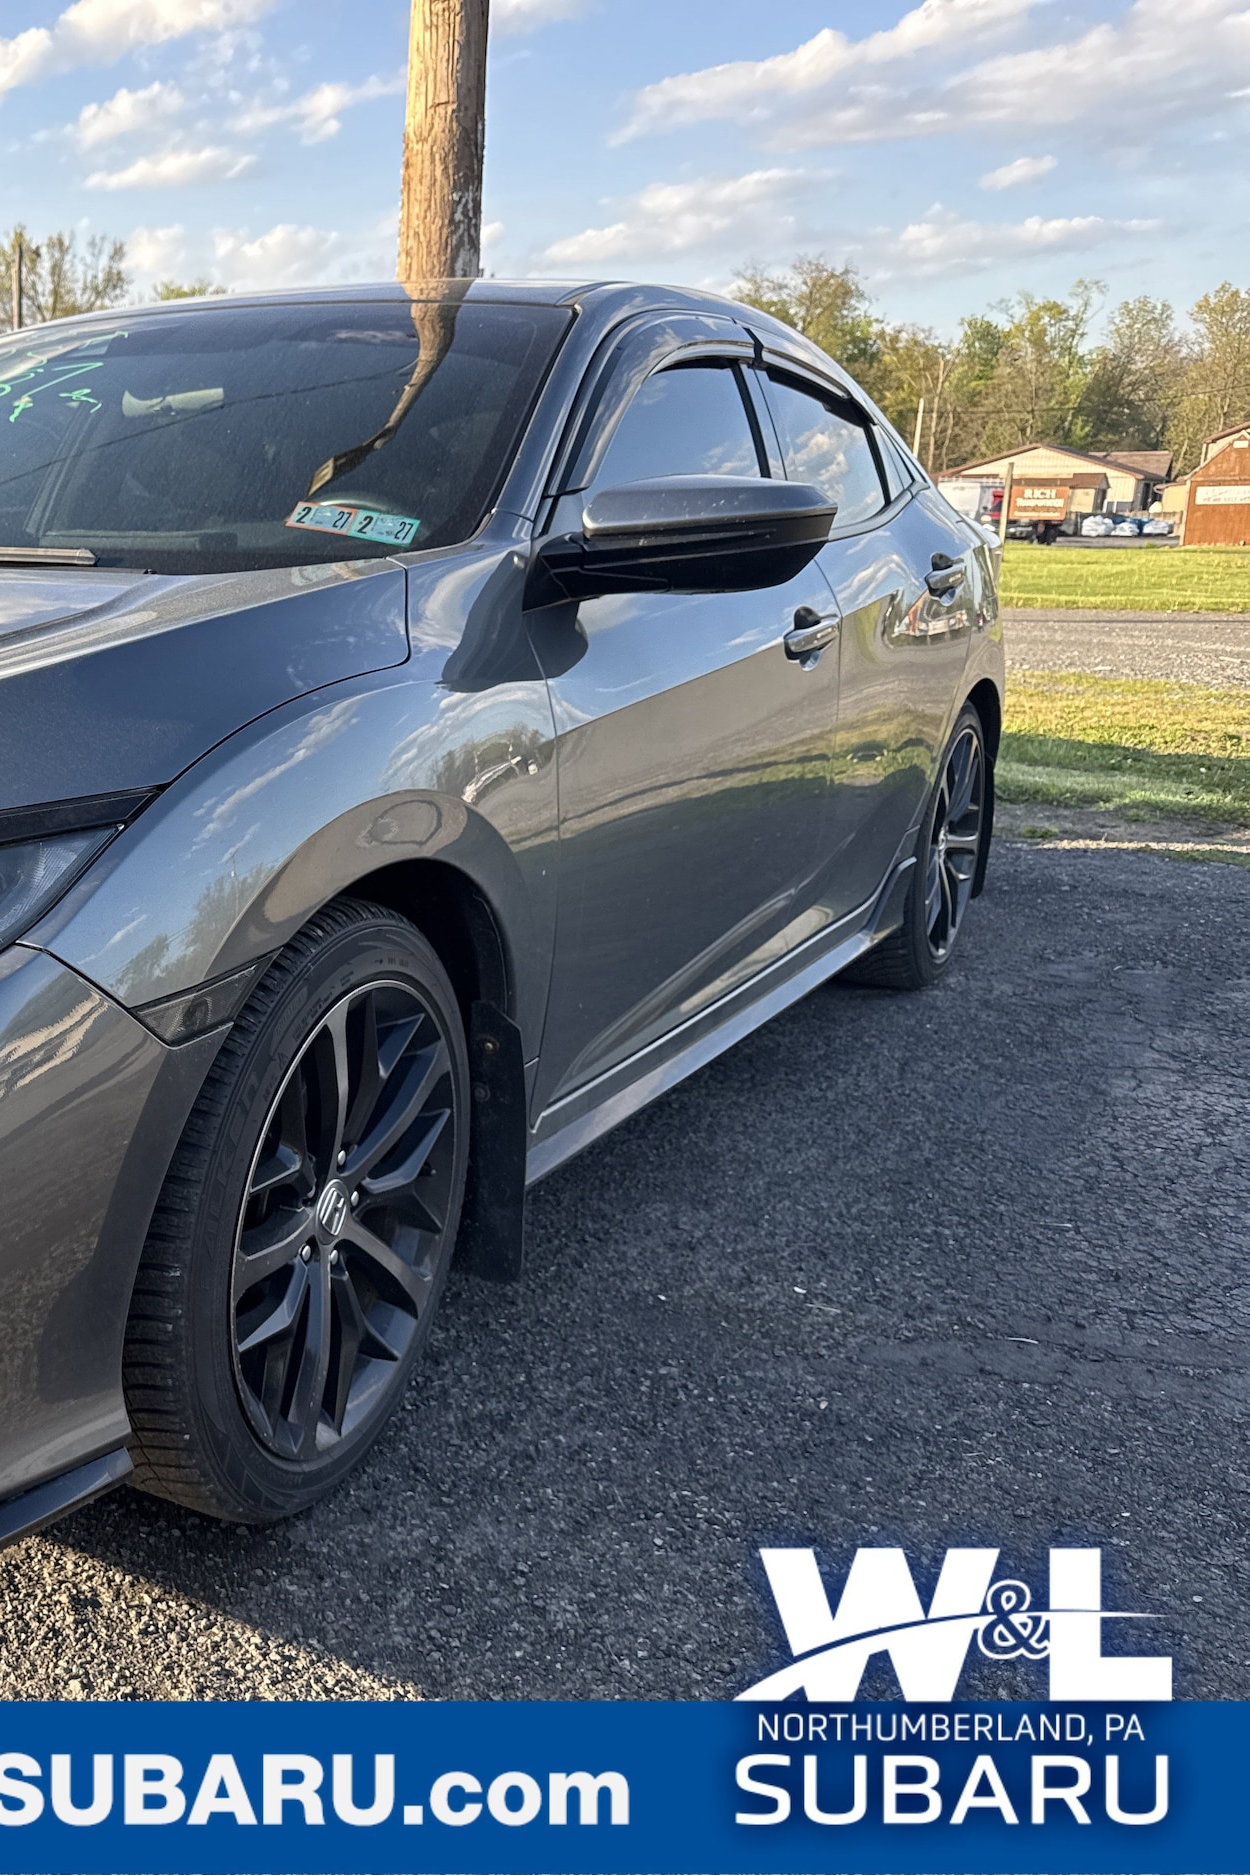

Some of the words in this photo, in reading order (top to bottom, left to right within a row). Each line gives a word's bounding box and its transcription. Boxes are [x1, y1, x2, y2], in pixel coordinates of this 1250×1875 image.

[1023, 488, 1057, 499] RICH
[297, 506, 312, 524] 2
[332, 510, 353, 531] 27
[357, 515, 374, 535] 2
[394, 521, 414, 541] 27
